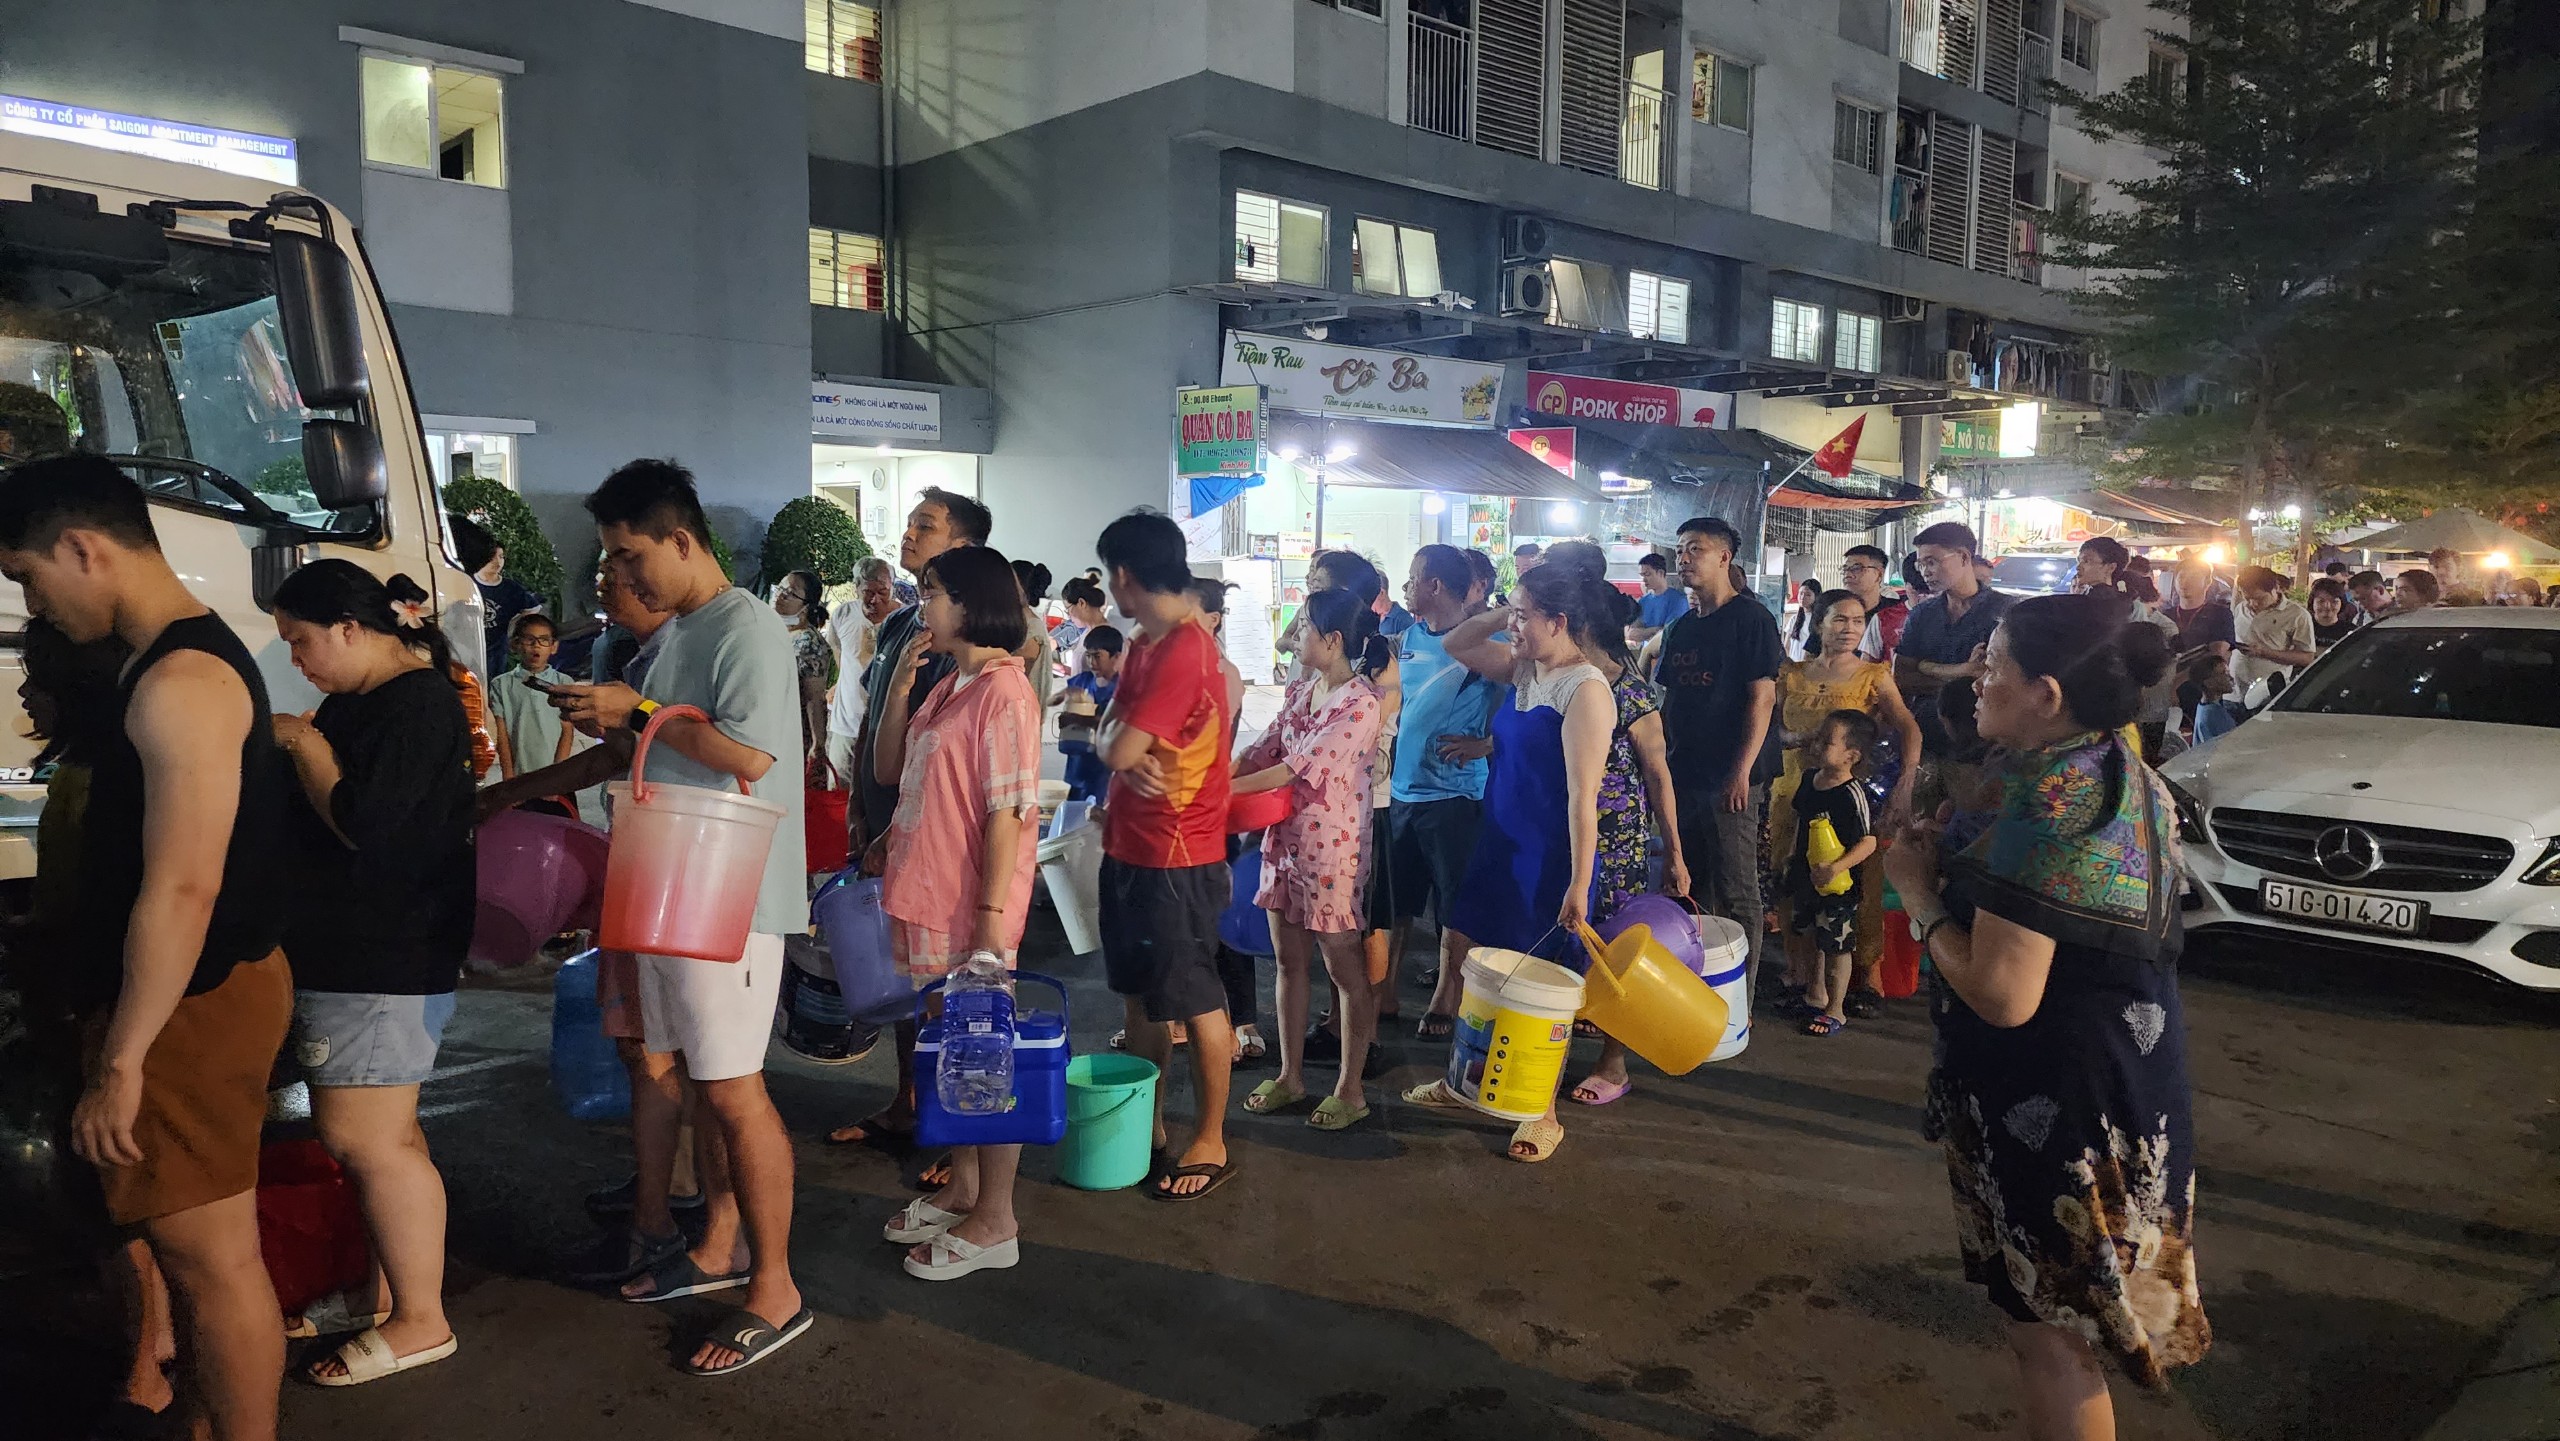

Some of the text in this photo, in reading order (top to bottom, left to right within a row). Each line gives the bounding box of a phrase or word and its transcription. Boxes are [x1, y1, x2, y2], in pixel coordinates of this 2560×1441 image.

[5, 102, 38, 119] CÔNG
[40, 108, 55, 121] TY
[109, 119, 149, 136] SAIGON
[151, 125, 215, 146] APARTMENT
[217, 135, 288, 156] MANAGEMENT
[1271, 346, 1305, 368] Rau
[1387, 357, 1430, 393] Ba
[844, 397, 866, 407] KHÔNG
[1541, 394, 1562, 412] CP
[1571, 397, 1667, 423] PORK SHOP
[1236, 410, 1255, 441] BA
[1534, 442, 1547, 450] CP
[2269, 885, 2412, 928] 51G-014.20
